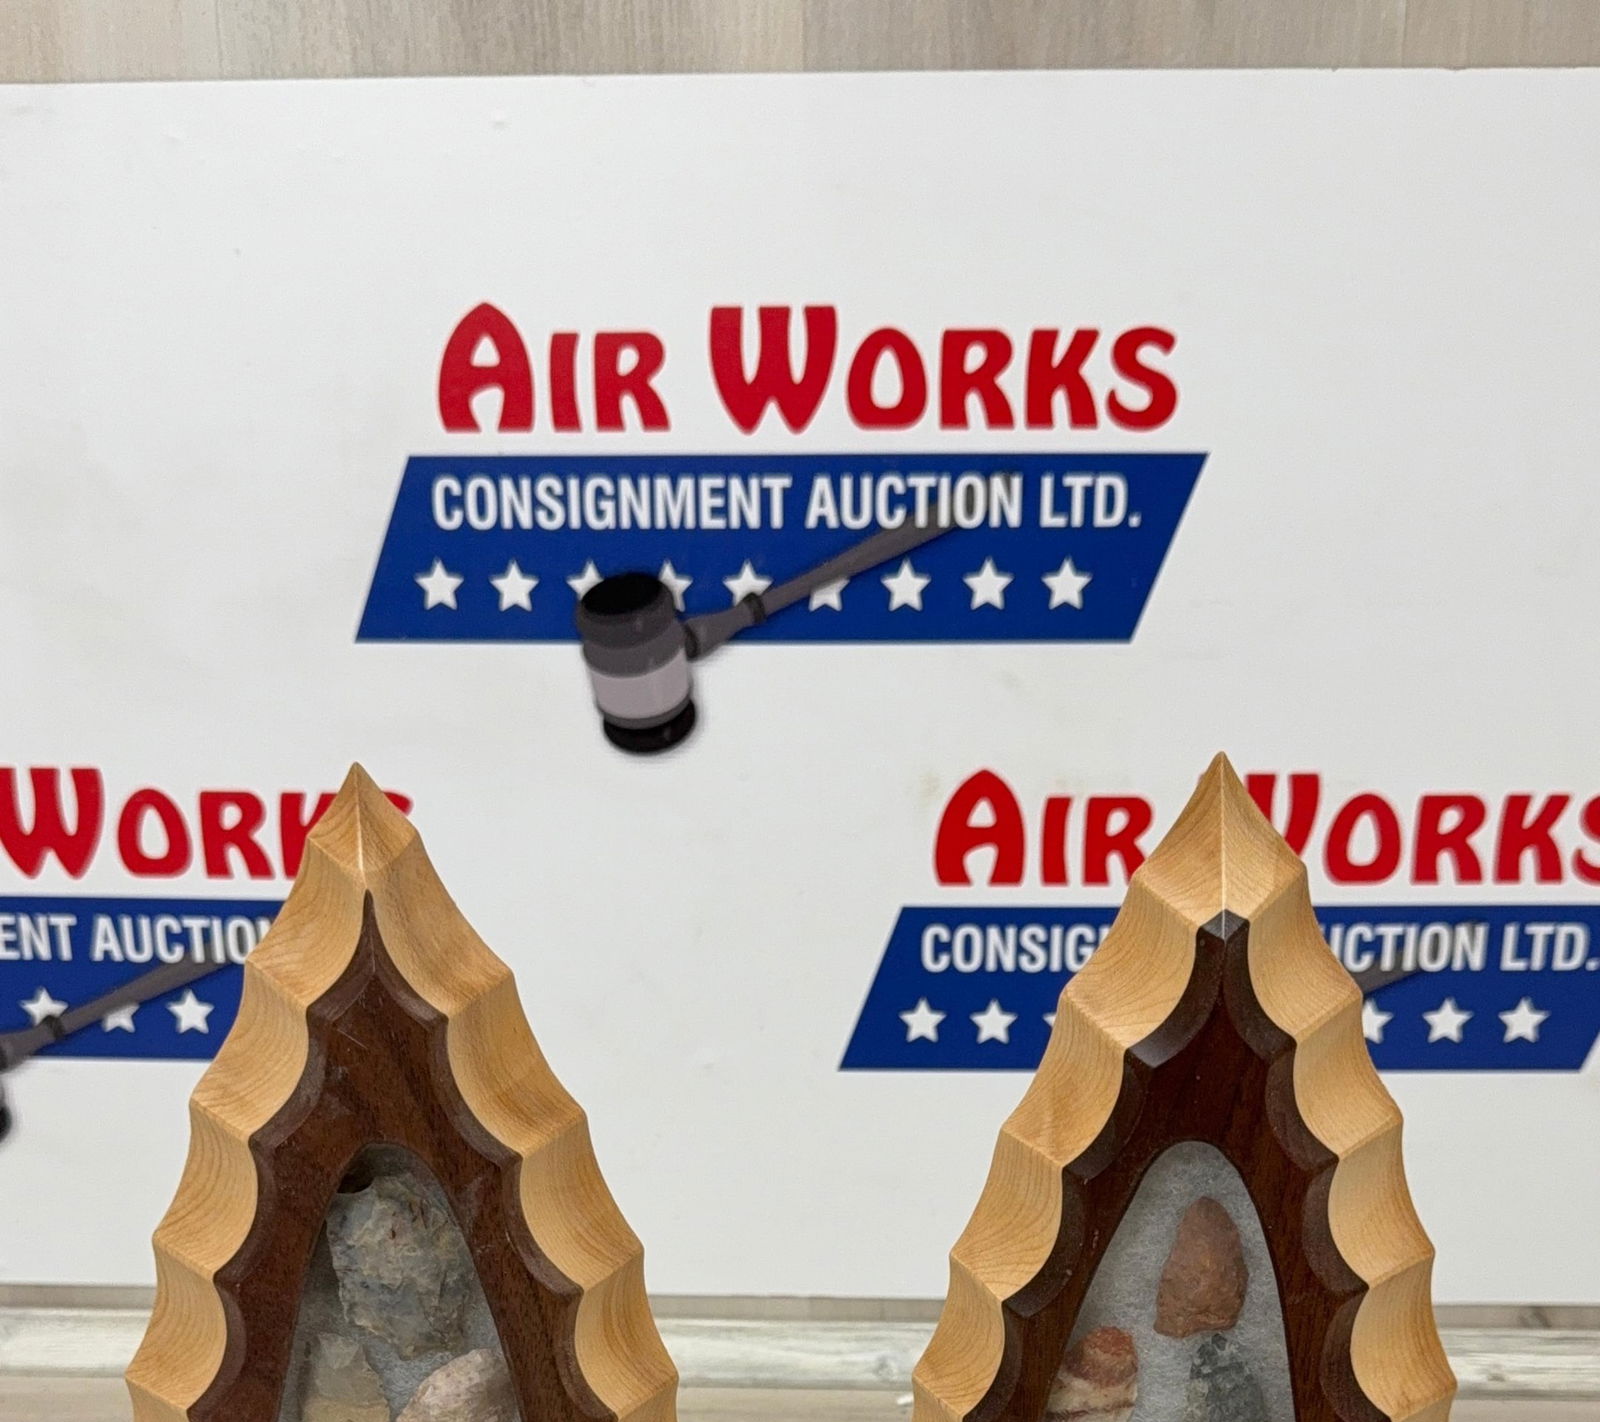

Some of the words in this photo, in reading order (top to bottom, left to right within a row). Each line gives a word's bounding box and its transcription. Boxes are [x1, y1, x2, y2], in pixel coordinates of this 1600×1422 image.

[437, 302, 671, 432] AIR
[709, 304, 1180, 433] WORKS
[431, 473, 793, 531] CONSIGNMENT
[804, 473, 1024, 531] AUCTION
[1039, 473, 1142, 529] LTD.
[0, 766, 414, 881] WORK
[933, 769, 1155, 887] AIR
[91, 914, 272, 964] AUCTIO
[920, 922, 1113, 973] CONSIG
[1499, 921, 1600, 971] LTD.
